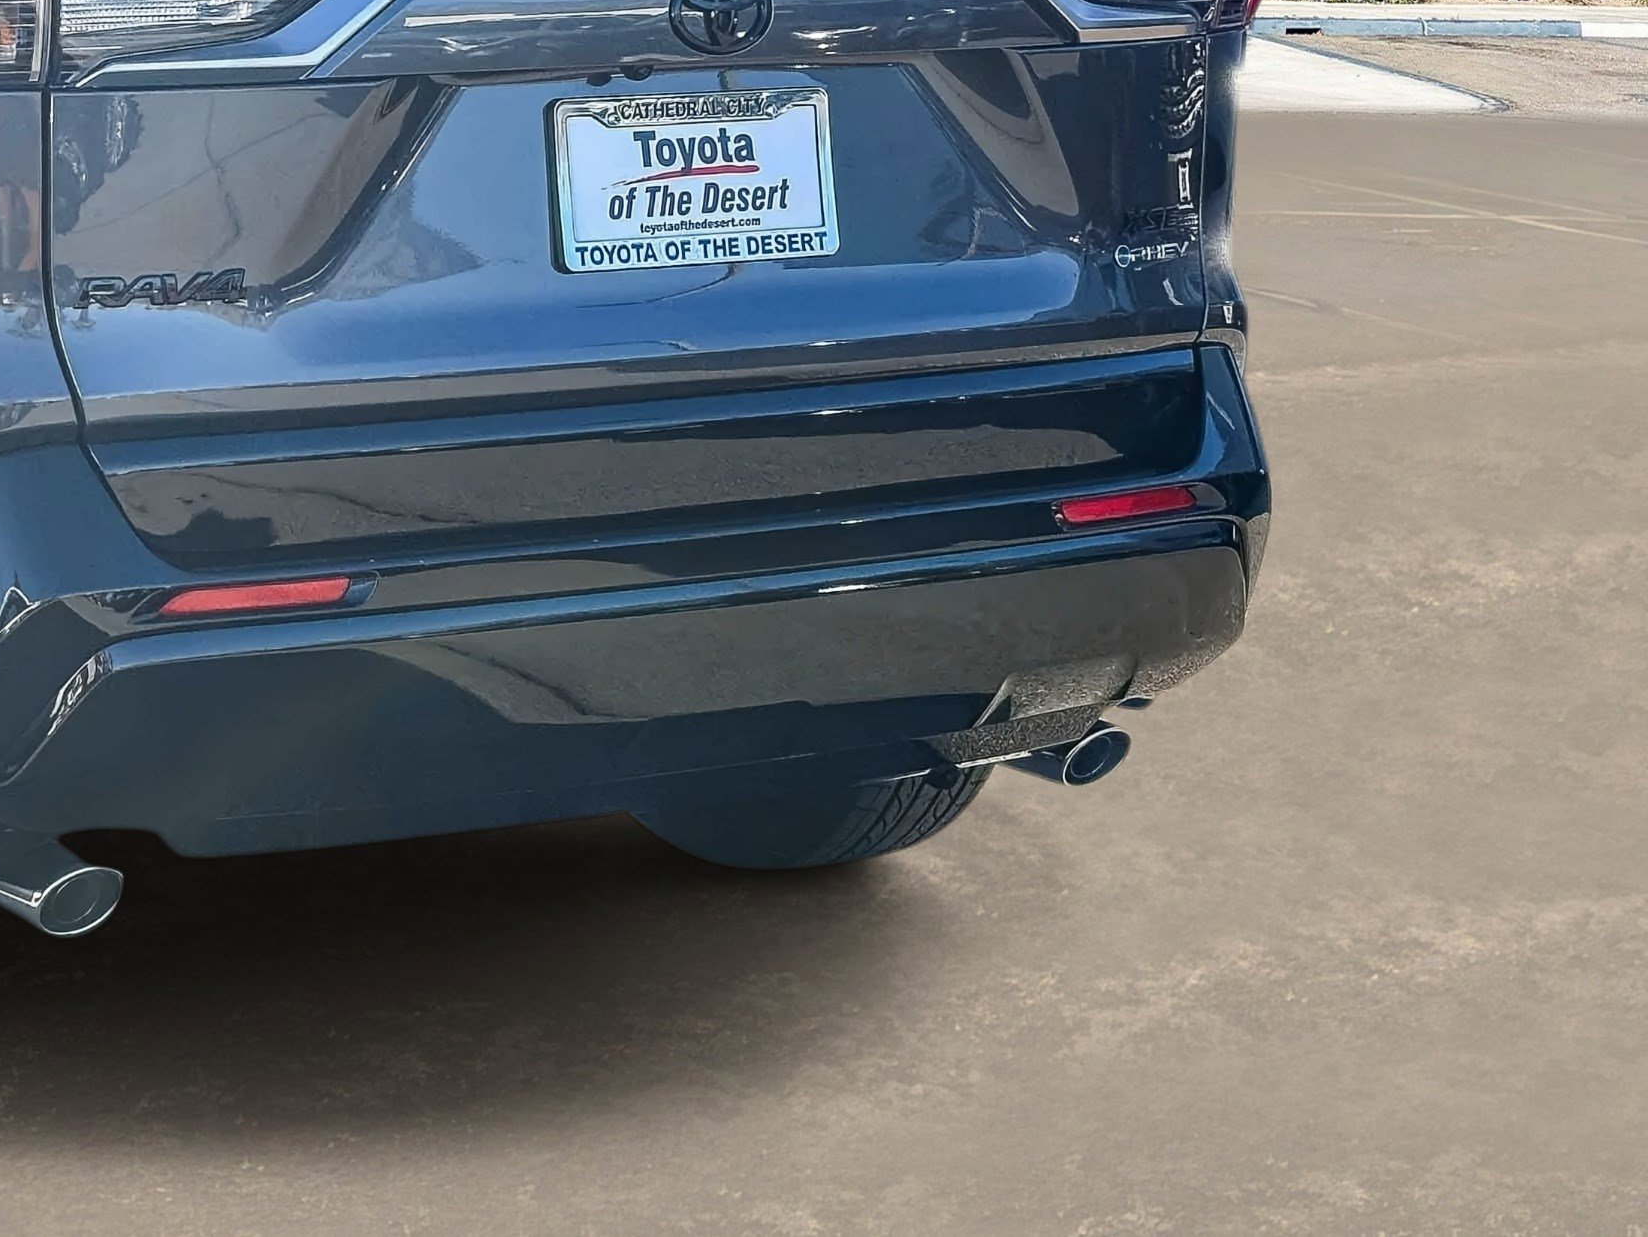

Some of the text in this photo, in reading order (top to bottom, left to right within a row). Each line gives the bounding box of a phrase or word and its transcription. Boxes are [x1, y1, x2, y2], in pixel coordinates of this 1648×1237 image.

[620, 96, 766, 121] CATHEDRAL CITY
[633, 128, 755, 173] Toyota
[609, 178, 790, 220] of The Desert
[640, 217, 761, 235] toyotaofthedesert.com
[575, 231, 828, 267] TOYOTA OF THE DESERT
[73, 267, 246, 310] RAV4
